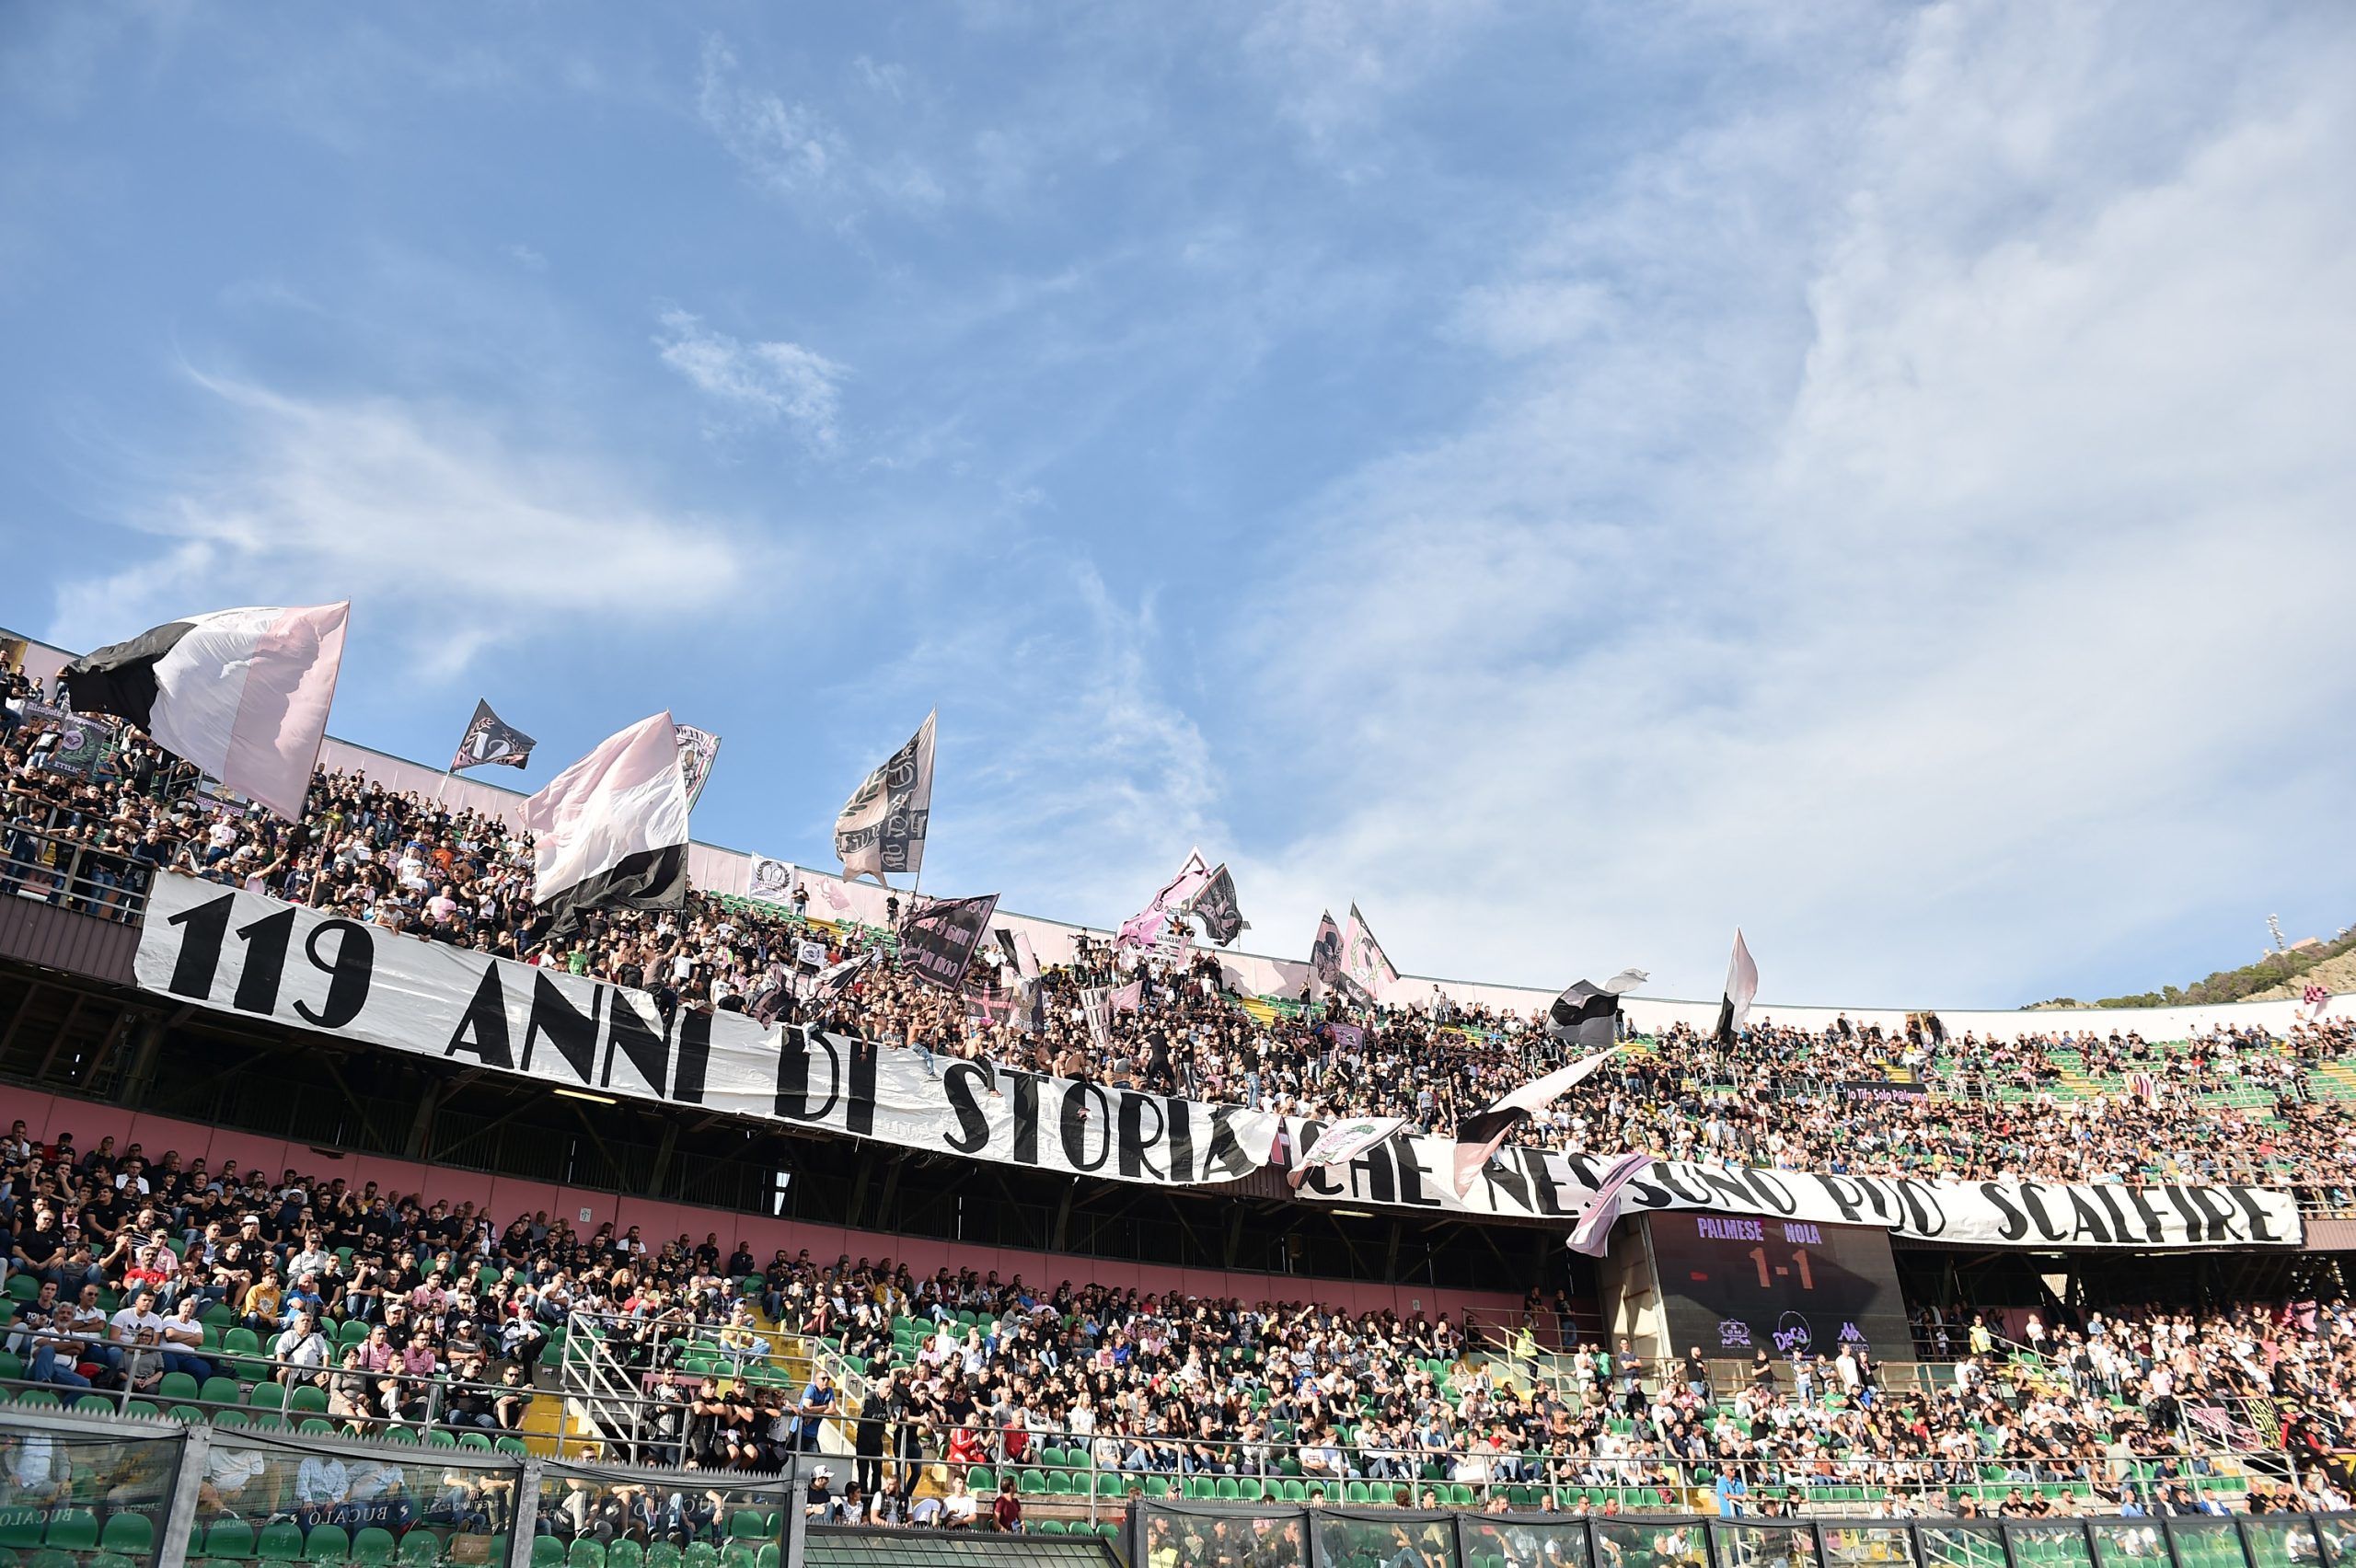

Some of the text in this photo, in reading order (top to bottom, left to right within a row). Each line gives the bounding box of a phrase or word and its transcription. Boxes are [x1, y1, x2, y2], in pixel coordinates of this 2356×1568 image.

[167, 892, 375, 1030] 119
[445, 958, 714, 1104] ANNI
[774, 1026, 877, 1136] DI
[943, 1062, 1257, 1182] STORIA
[1299, 1120, 1442, 1206] CHE
[1981, 1182, 2282, 1243] SCALFIRE
[1873, 1089, 1891, 1101] Solo
[1697, 1217, 1822, 1244] PALMESE NOLA
